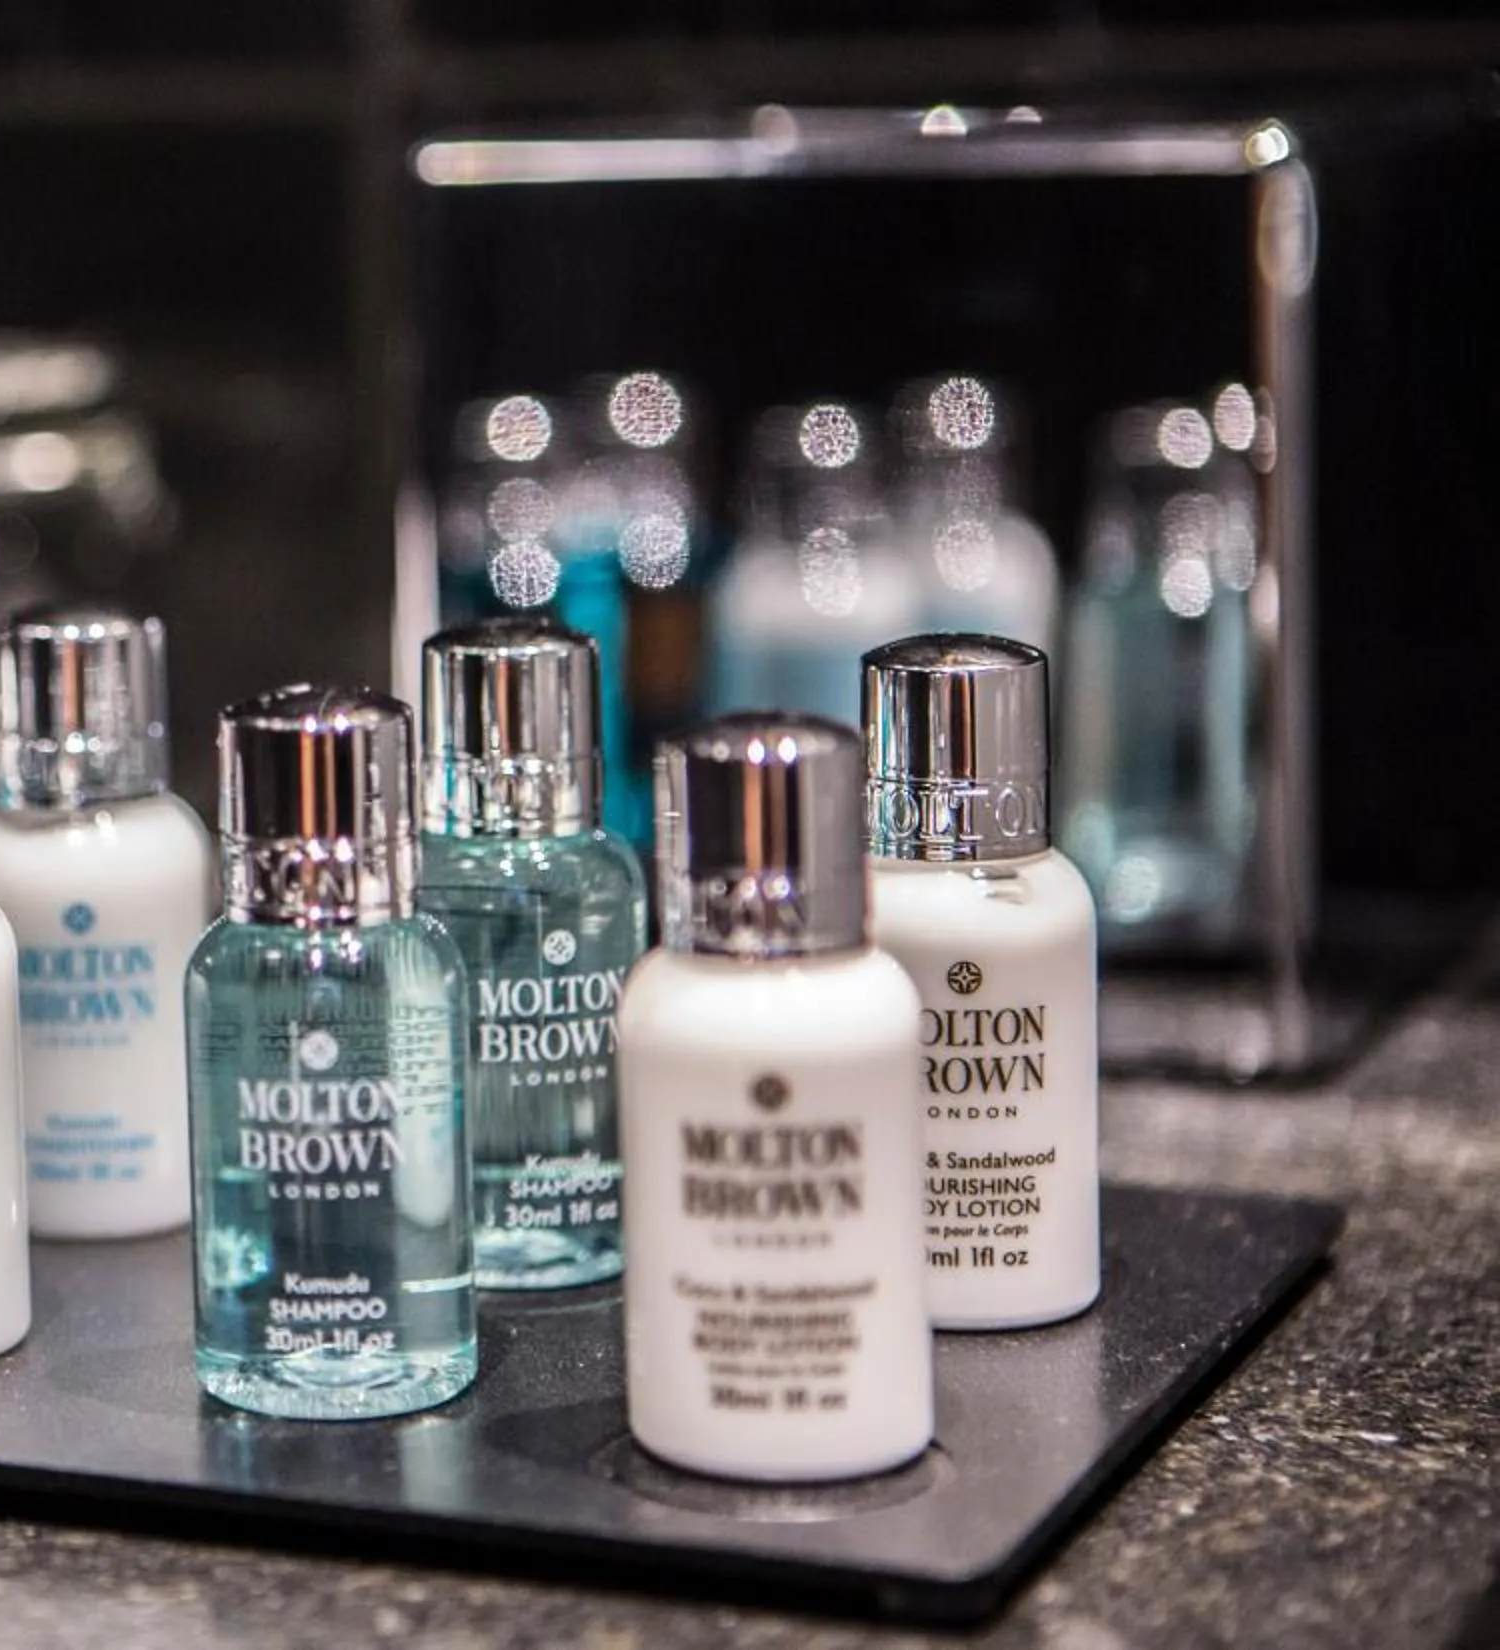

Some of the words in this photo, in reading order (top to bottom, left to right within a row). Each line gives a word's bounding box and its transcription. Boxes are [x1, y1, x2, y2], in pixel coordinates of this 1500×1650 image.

[478, 965, 627, 1018] MOLTON
[920, 1005, 1045, 1046] OLTON
[510, 1065, 607, 1086] LONDON
[921, 1053, 1045, 1095] ROWN
[237, 1078, 402, 1124] MOLTON
[927, 1106, 1018, 1119] ONDON
[240, 1127, 405, 1174] BROWN
[926, 1151, 940, 1169] &
[947, 1146, 1056, 1169] Sandalwood
[268, 1182, 380, 1200] LONDON
[925, 1176, 1036, 1195] URISHING
[504, 1203, 562, 1228] 30ml
[957, 1197, 1041, 1217] LOTION
[1003, 1251, 1029, 1267] oz
[269, 1298, 387, 1321] SHAMPOO
